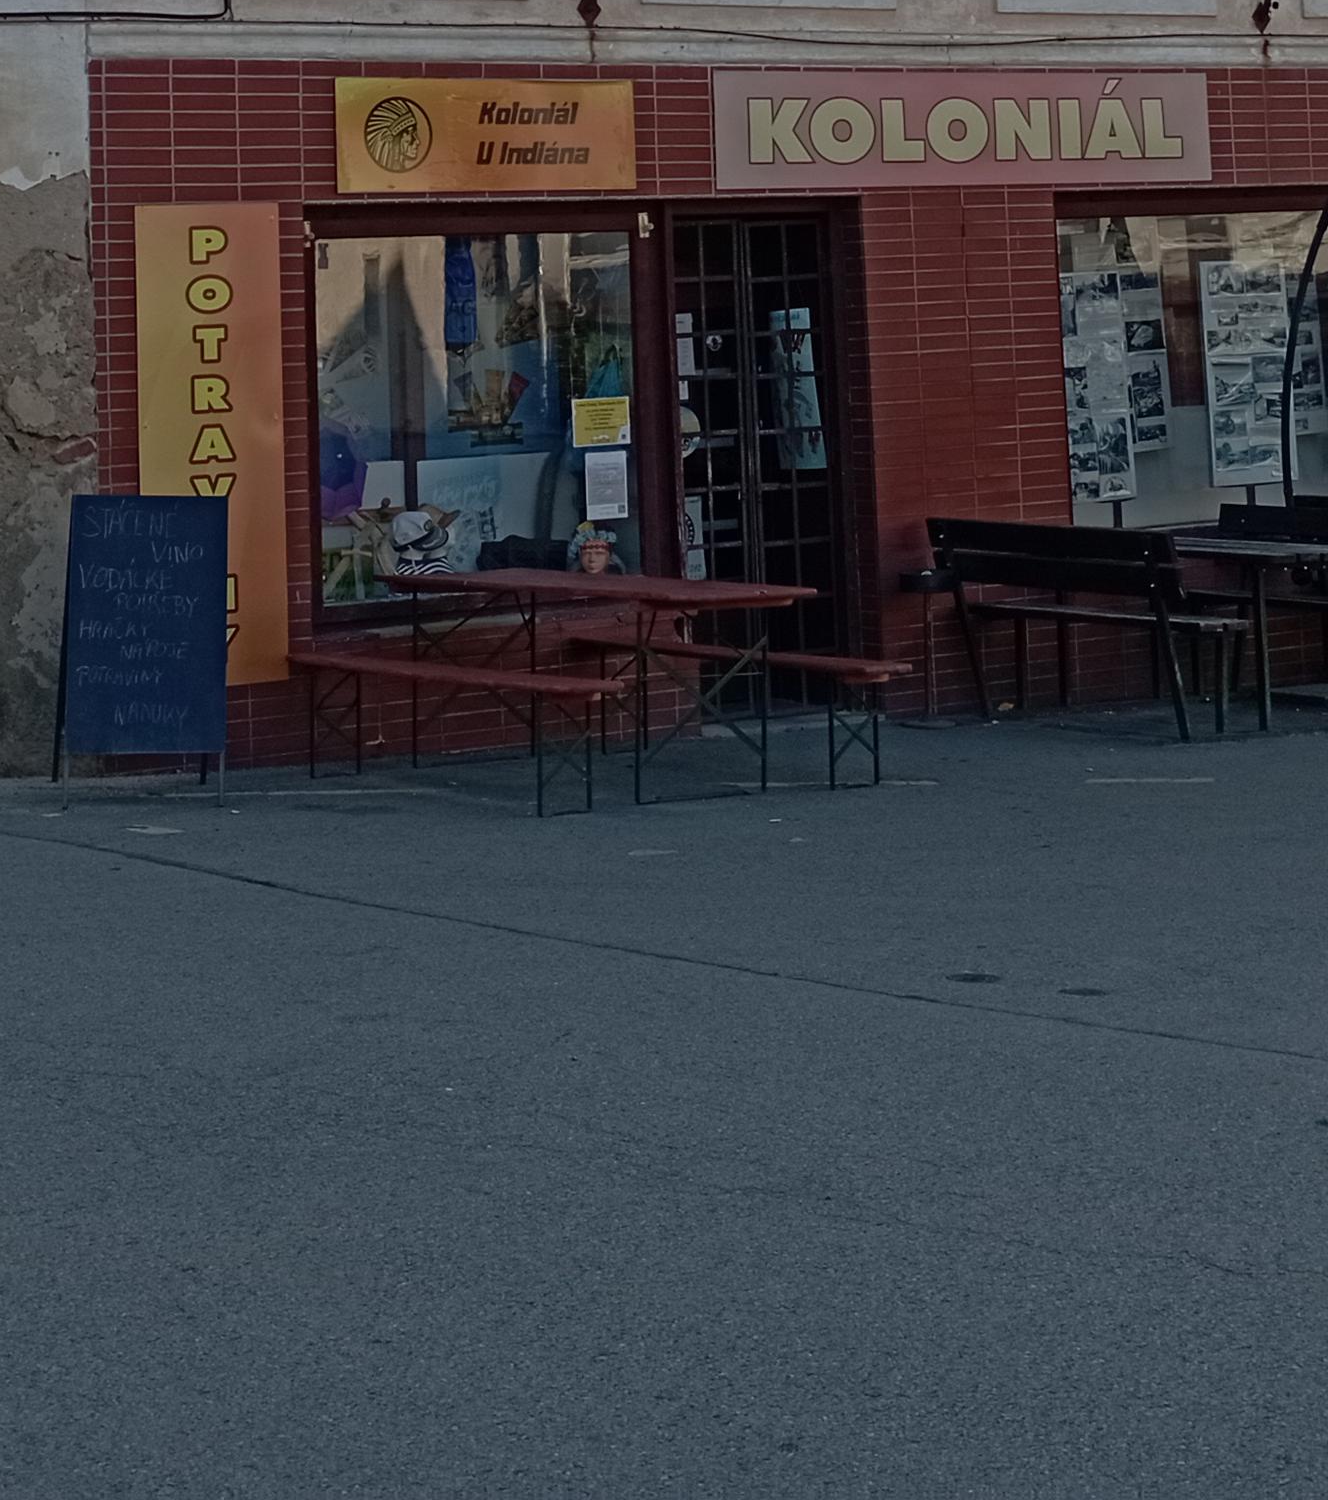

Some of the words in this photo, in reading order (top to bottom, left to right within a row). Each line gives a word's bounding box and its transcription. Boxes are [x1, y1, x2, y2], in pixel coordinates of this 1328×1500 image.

[478, 101, 579, 125] Koloniál
[747, 77, 1184, 165] KOLONIÁL
[476, 141, 495, 165] U
[499, 141, 590, 165] Indiána
